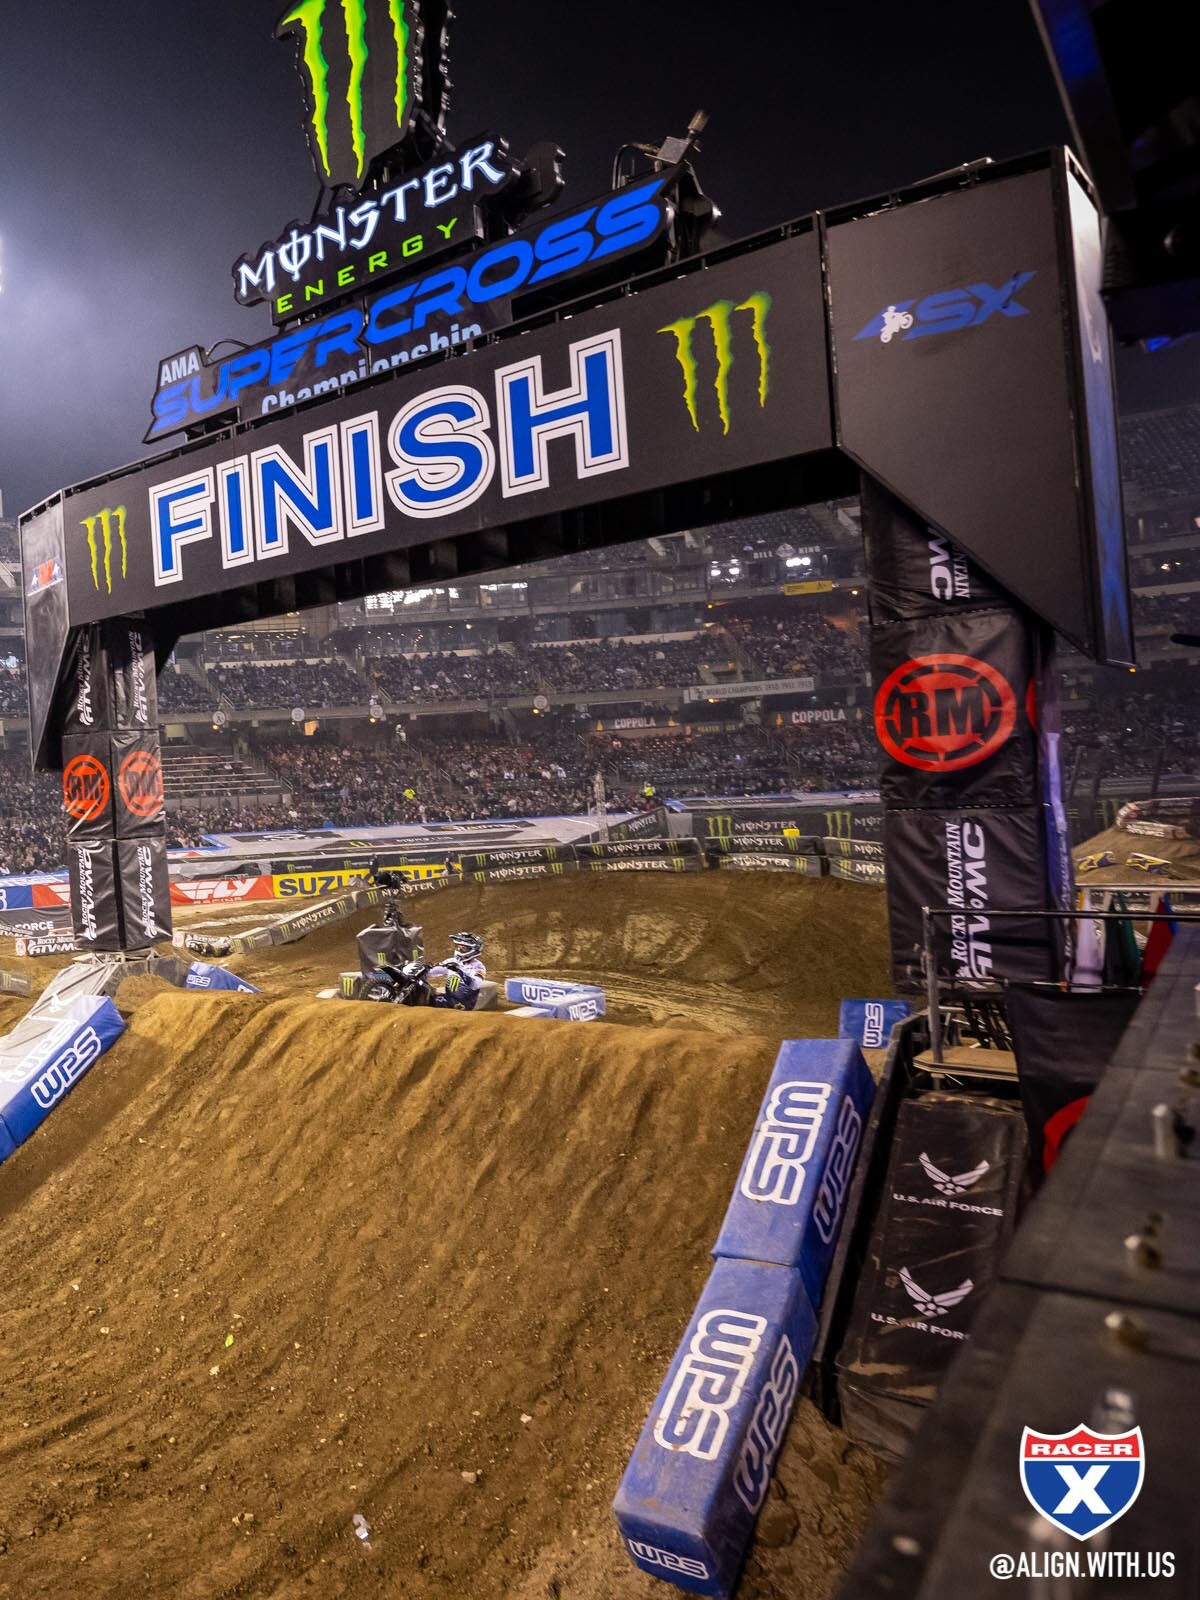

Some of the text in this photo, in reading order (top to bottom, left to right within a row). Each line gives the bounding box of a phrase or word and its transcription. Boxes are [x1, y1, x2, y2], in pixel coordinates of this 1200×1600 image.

[238, 141, 506, 297] MONSTER
[276, 217, 459, 314] ENERGY
[152, 178, 666, 432] SUPERCROSS
[160, 356, 199, 386] AMA
[261, 320, 482, 416] Championship
[149, 327, 630, 587] FINISH
[614, 718, 656, 729] COPPOLA
[791, 708, 846, 724] COPPOLA
[902, 687, 984, 738] RM
[733, 837, 784, 847] MONSTER
[735, 821, 797, 831] MONSTER
[490, 850, 543, 862] MONSTER
[607, 843, 662, 853] MONSTER
[607, 860, 668, 871] MONSTER
[945, 822, 965, 909] MOUNTAIN
[175, 878, 258, 900] FLY
[489, 865, 547, 879] MONSTER
[292, 906, 335, 930] MONSTER
[863, 1003, 884, 1048] WPS
[30, 1026, 102, 1108] WPS
[741, 1081, 832, 1206] WPS
[813, 1096, 861, 1245] WPS
[922, 1199, 947, 1208] AIR
[950, 1202, 1004, 1217] FORCE
[929, 1324, 971, 1342] FOR
[653, 1309, 768, 1461] WPS
[732, 1336, 803, 1514] WPS
[627, 1539, 710, 1580] WPS
